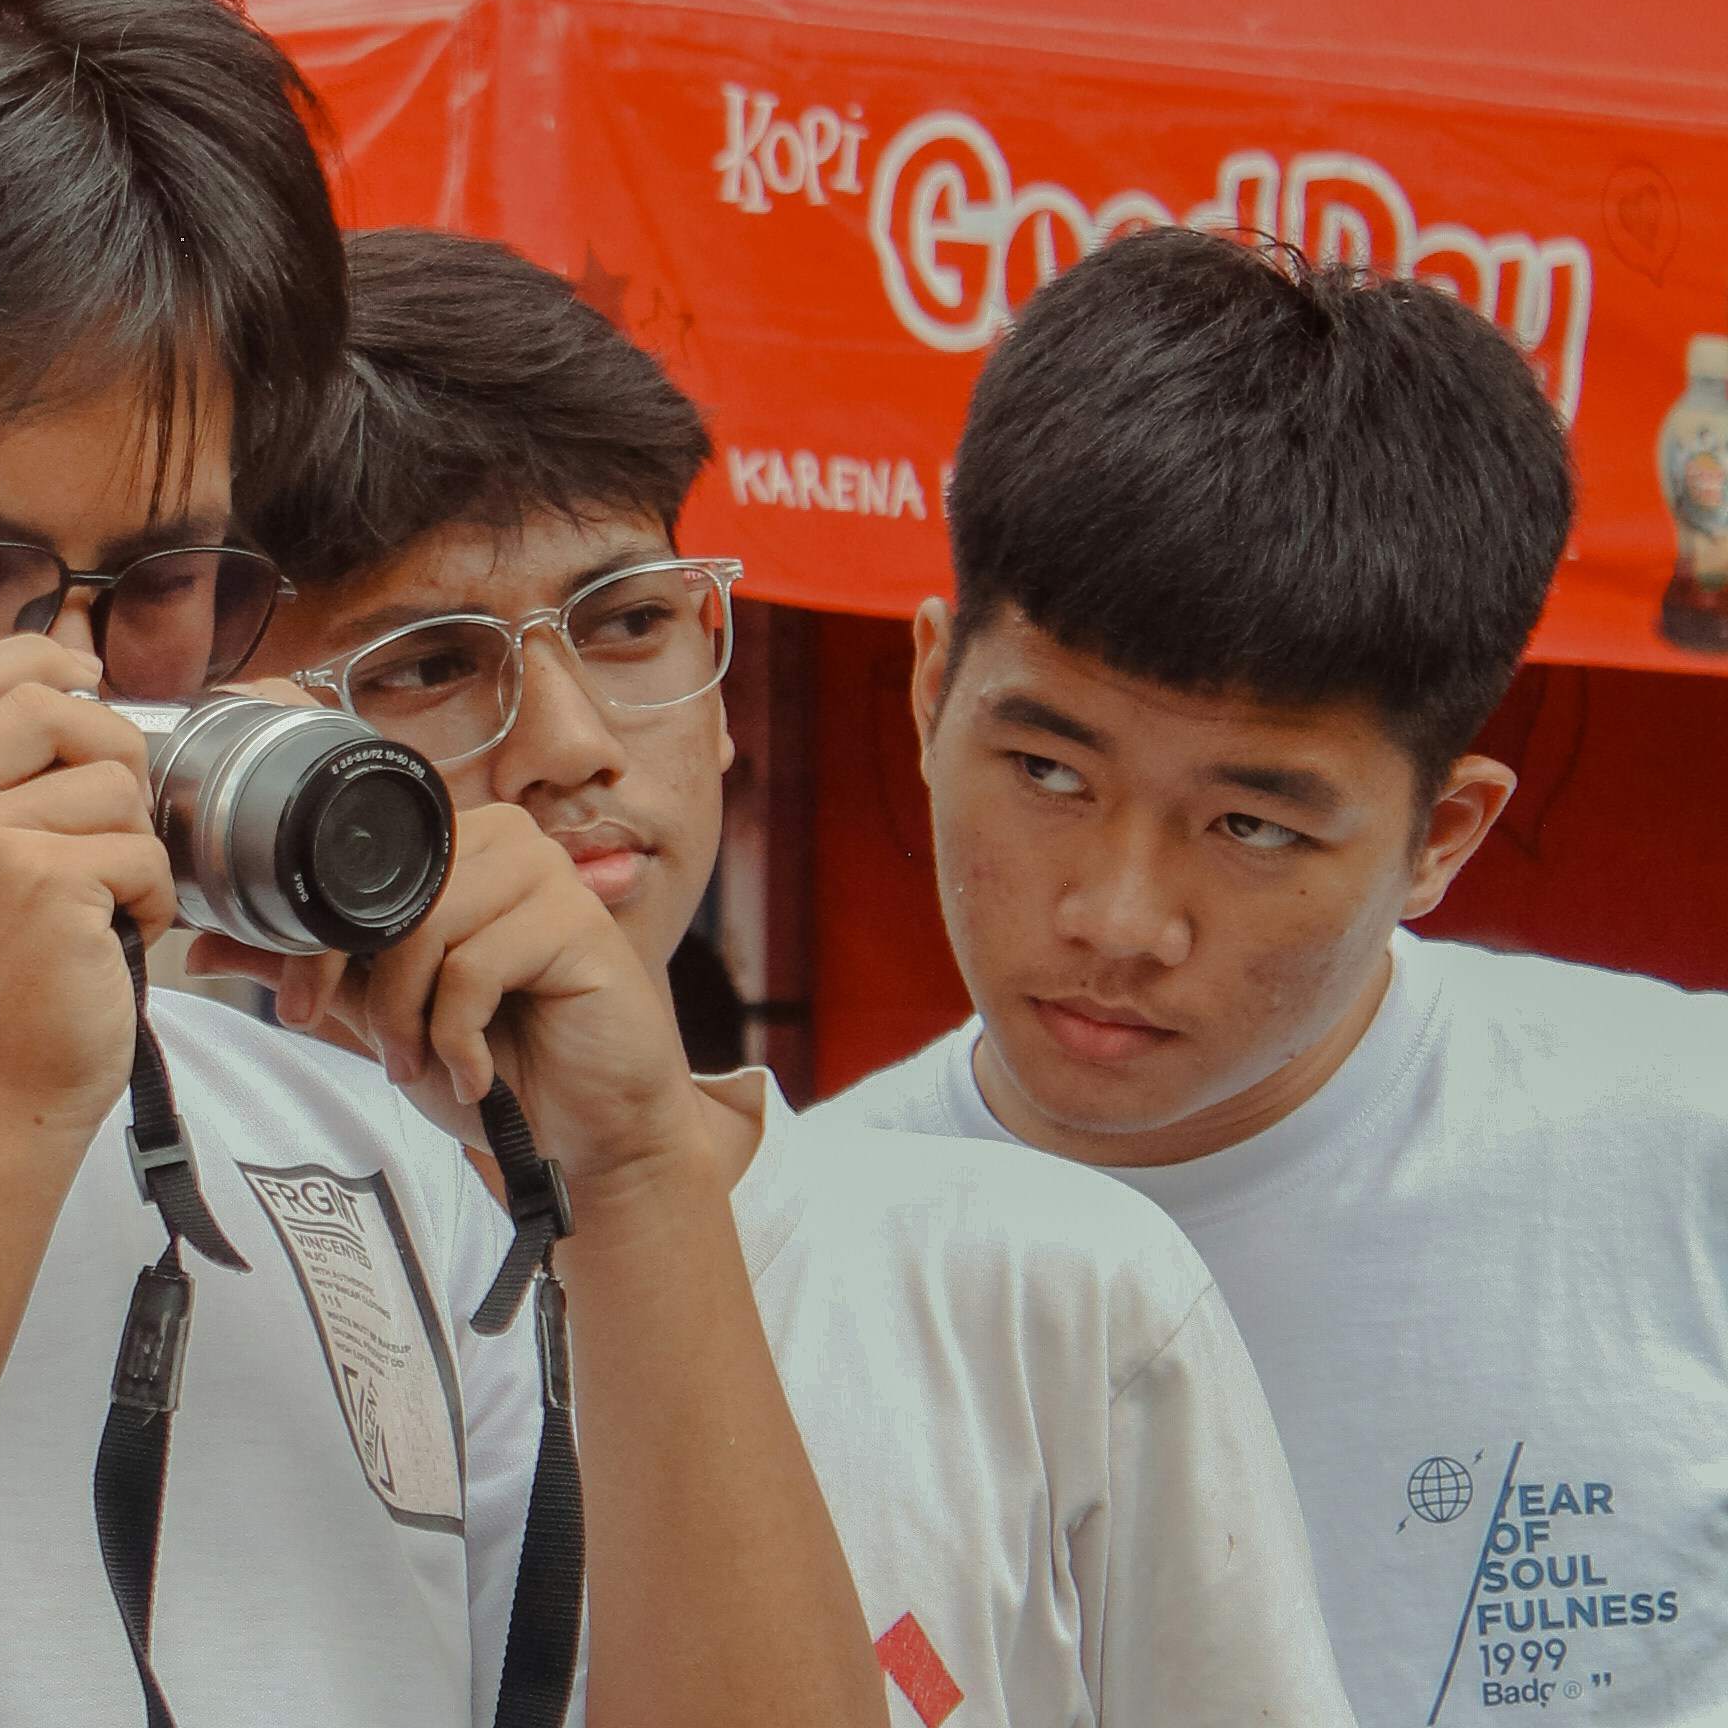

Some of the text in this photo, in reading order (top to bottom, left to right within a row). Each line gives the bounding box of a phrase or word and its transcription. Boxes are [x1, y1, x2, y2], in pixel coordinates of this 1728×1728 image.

[726, 444, 929, 522] KARENA
[256, 1176, 368, 1234] FRGMT
[1489, 1520, 1550, 1555] OF
[1482, 1554, 1607, 1593] SOUL
[1476, 1591, 1679, 1636] FULNESS
[1479, 1637, 1567, 1677] 1999
